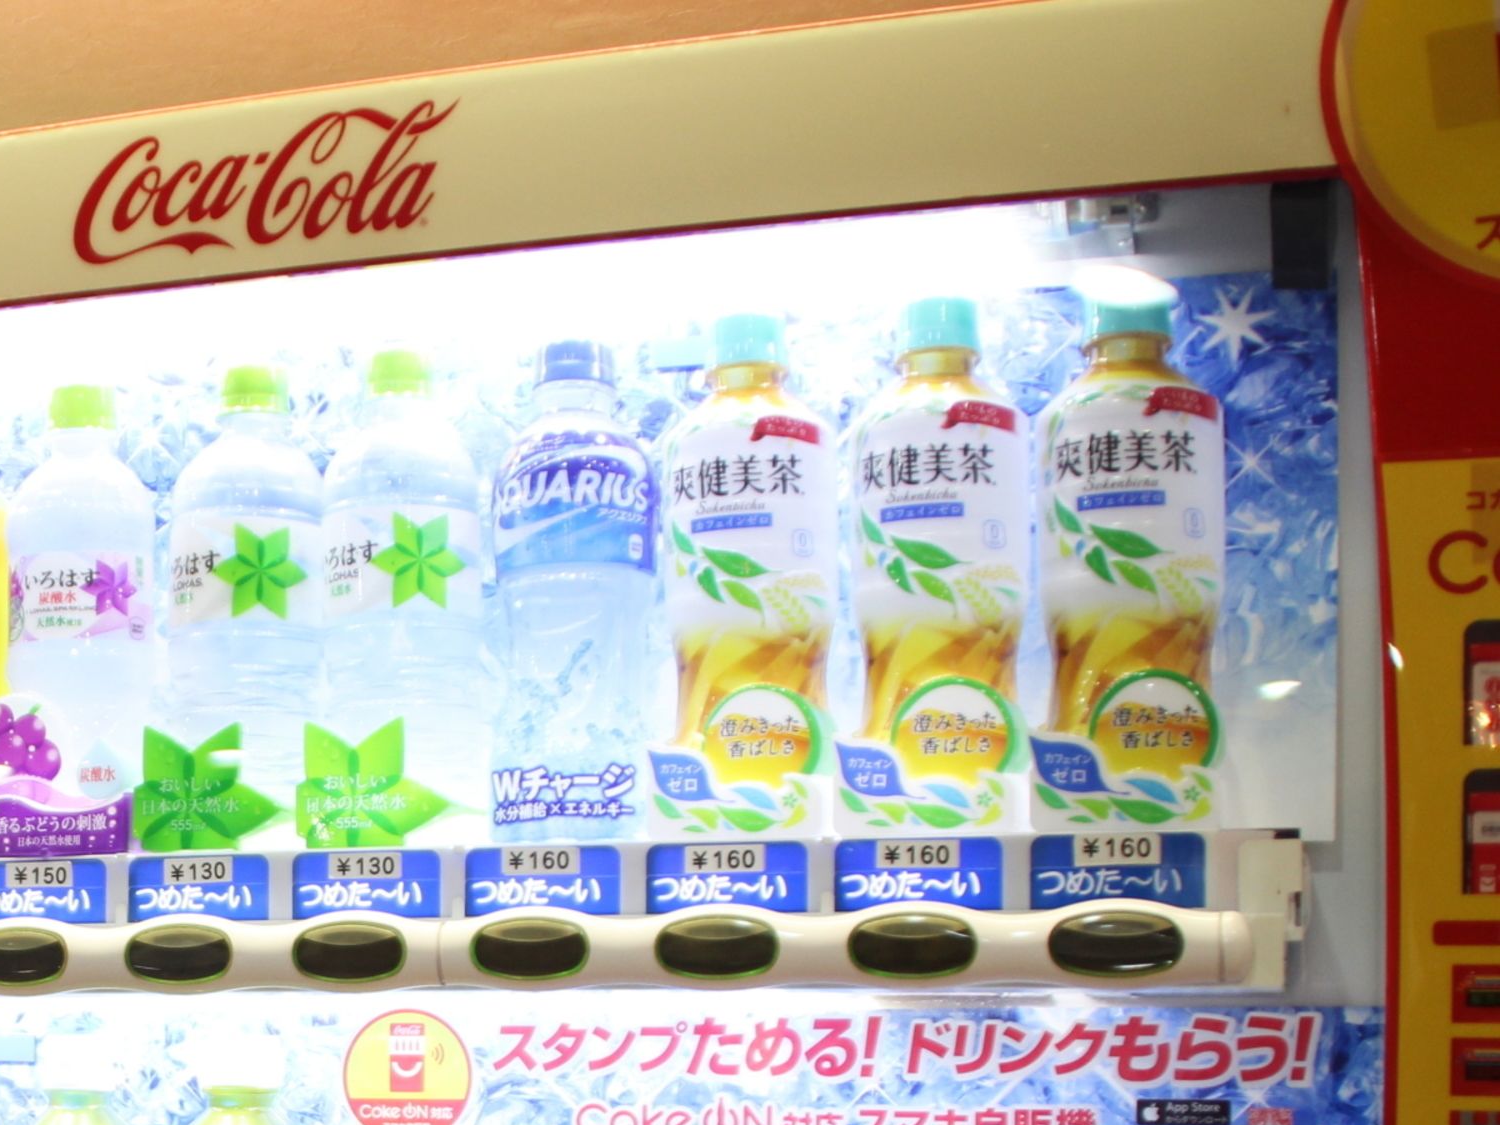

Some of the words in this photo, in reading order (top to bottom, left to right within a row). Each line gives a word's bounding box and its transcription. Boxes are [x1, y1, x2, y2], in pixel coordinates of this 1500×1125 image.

[73, 96, 461, 264] Coca-Cola
[1055, 428, 1196, 483] 爽健美茶
[862, 442, 996, 493] 爽健美茶
[673, 453, 802, 505] 爽健美茶
[693, 516, 771, 532] カフェインゼロ
[25, 568, 101, 591] いろはす
[720, 716, 802, 739] 澄みきった
[913, 712, 997, 736] 澄みきった
[1112, 706, 1200, 731] 澄みきった
[727, 740, 795, 759] 香ばしさ
[921, 737, 992, 756] 香ばしさ
[1121, 731, 1192, 750] 香ばしさ
[660, 761, 701, 776] カフェイン
[847, 756, 893, 773] カフェイン
[80, 767, 116, 783] 炭酸水
[492, 761, 636, 803] Wチャージ
[667, 776, 700, 793] ゼロ
[853, 773, 888, 790] ゼロ
[1052, 768, 1088, 785] ゼロ
[141, 795, 240, 817] 日本の天然水
[305, 794, 407, 814] 日本の天然水
[17, 834, 81, 848] 日本の天然水使用
[1082, 838, 1152, 860] ¥160
[509, 850, 570, 871] ¥160
[692, 850, 757, 870] ¥160
[884, 845, 950, 866] ¥160
[14, 866, 68, 886] ¥150
[171, 861, 226, 881] ¥130
[336, 856, 395, 876] ¥130
[493, 1015, 884, 1078] スタンプためる!
[906, 1011, 1318, 1084] ドリンクもらう!
[359, 1103, 401, 1119] Coke
[1166, 1101, 1192, 1116] App
[1195, 1101, 1220, 1114] Store
